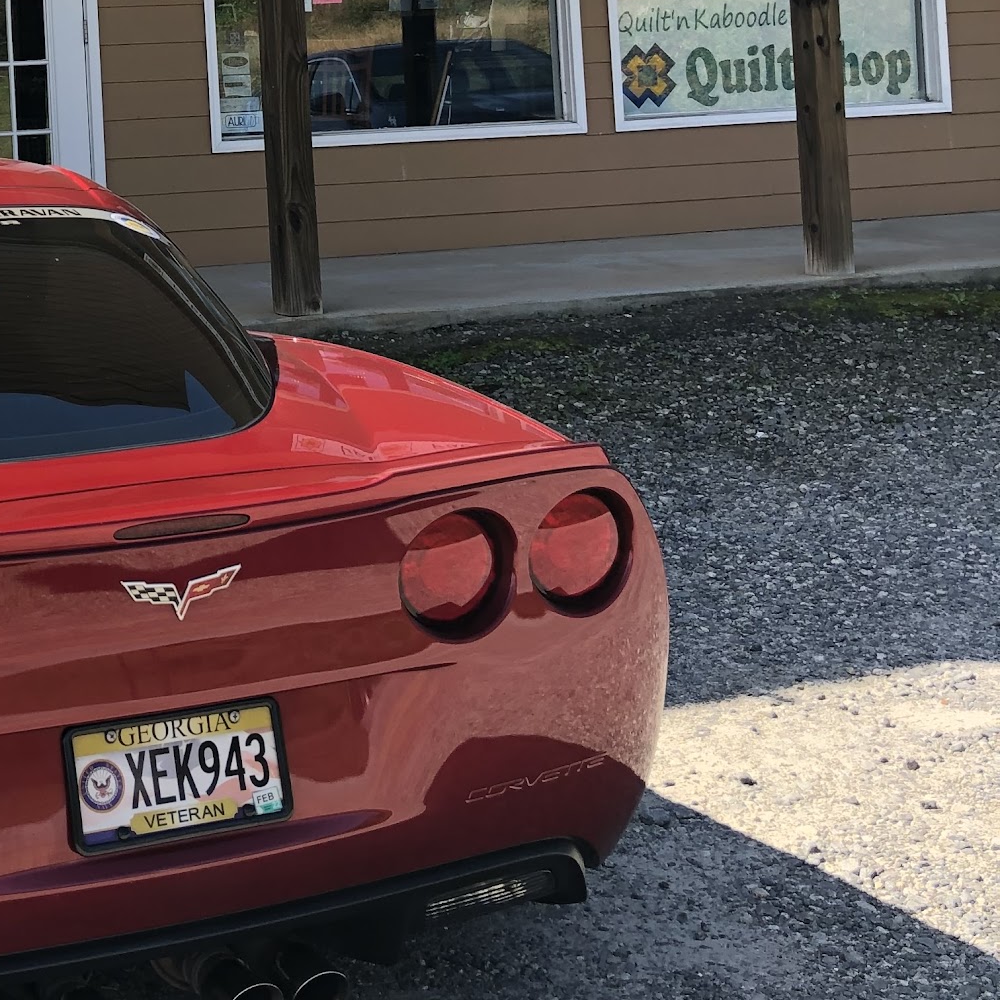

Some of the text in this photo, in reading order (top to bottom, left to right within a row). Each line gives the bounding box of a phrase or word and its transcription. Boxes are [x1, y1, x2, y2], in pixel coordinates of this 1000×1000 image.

[694, 1, 788, 31] Kaboodle
[685, 44, 795, 107] Quilt
[117, 713, 231, 747] GEORGIA
[125, 733, 270, 810] XEK943
[465, 750, 609, 803] CORVETTE
[256, 792, 275, 804] FEB
[144, 803, 225, 829] VETERAN
